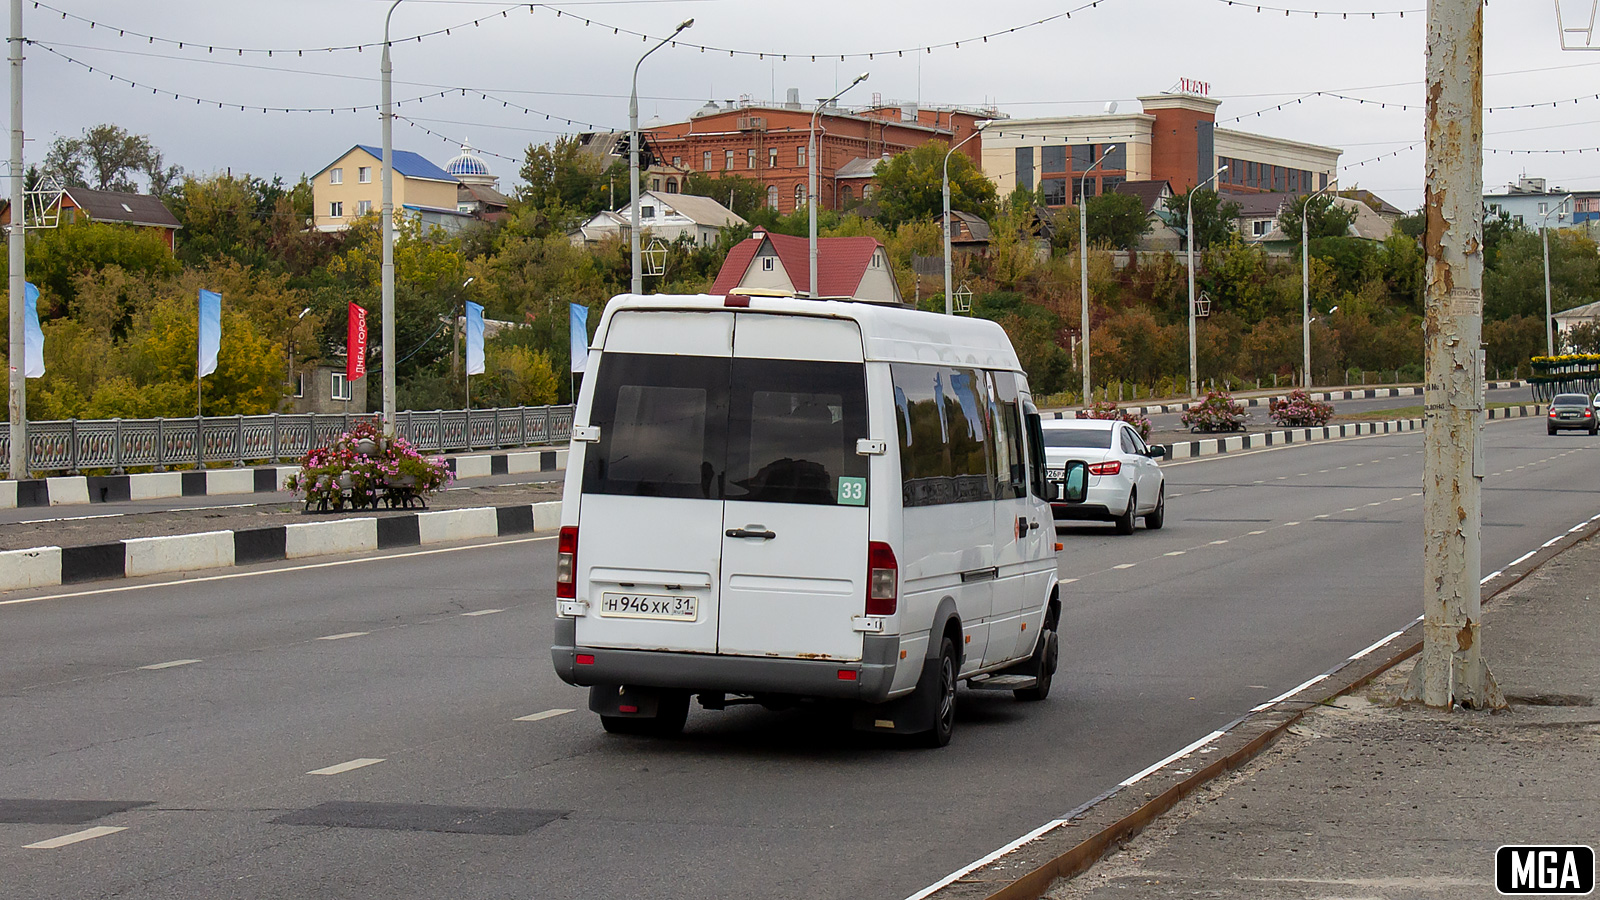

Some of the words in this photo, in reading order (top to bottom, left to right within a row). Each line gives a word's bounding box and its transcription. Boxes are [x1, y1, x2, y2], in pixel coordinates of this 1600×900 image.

[1180, 77, 1211, 96] ТЕАТР
[358, 308, 366, 344] ГОРОДА
[355, 346, 366, 374] ДНЕМ
[842, 482, 862, 499] 33
[675, 598, 690, 610] 31
